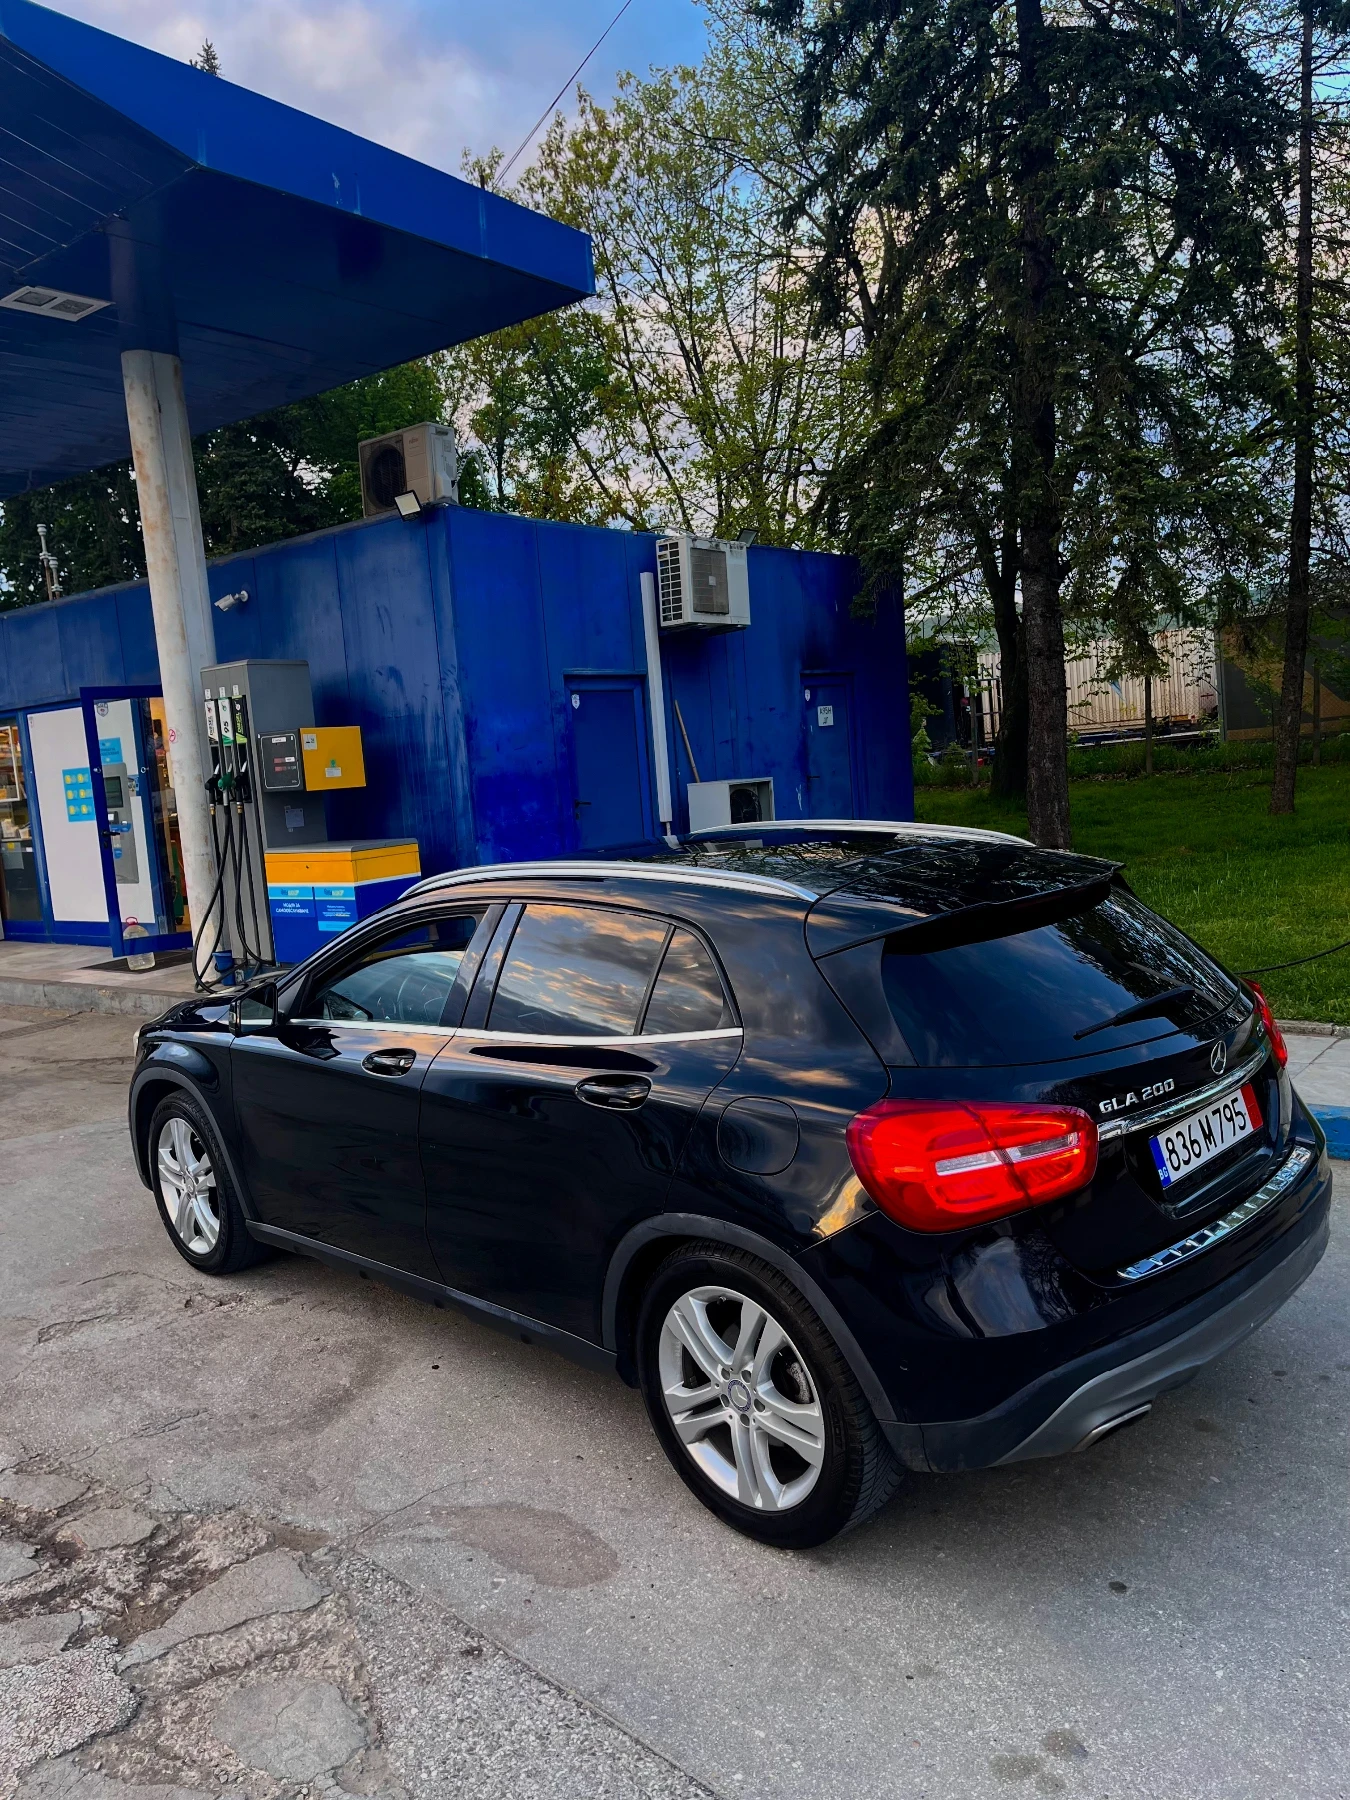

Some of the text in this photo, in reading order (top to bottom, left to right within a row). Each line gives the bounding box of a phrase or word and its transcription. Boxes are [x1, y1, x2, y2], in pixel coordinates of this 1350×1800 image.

[224, 721, 230, 733] 95
[1099, 1078, 1175, 1114] GLA 200
[1165, 1123, 1202, 1172] 836
[1212, 1097, 1247, 1144] 795
[1158, 1166, 1169, 1180] BG
